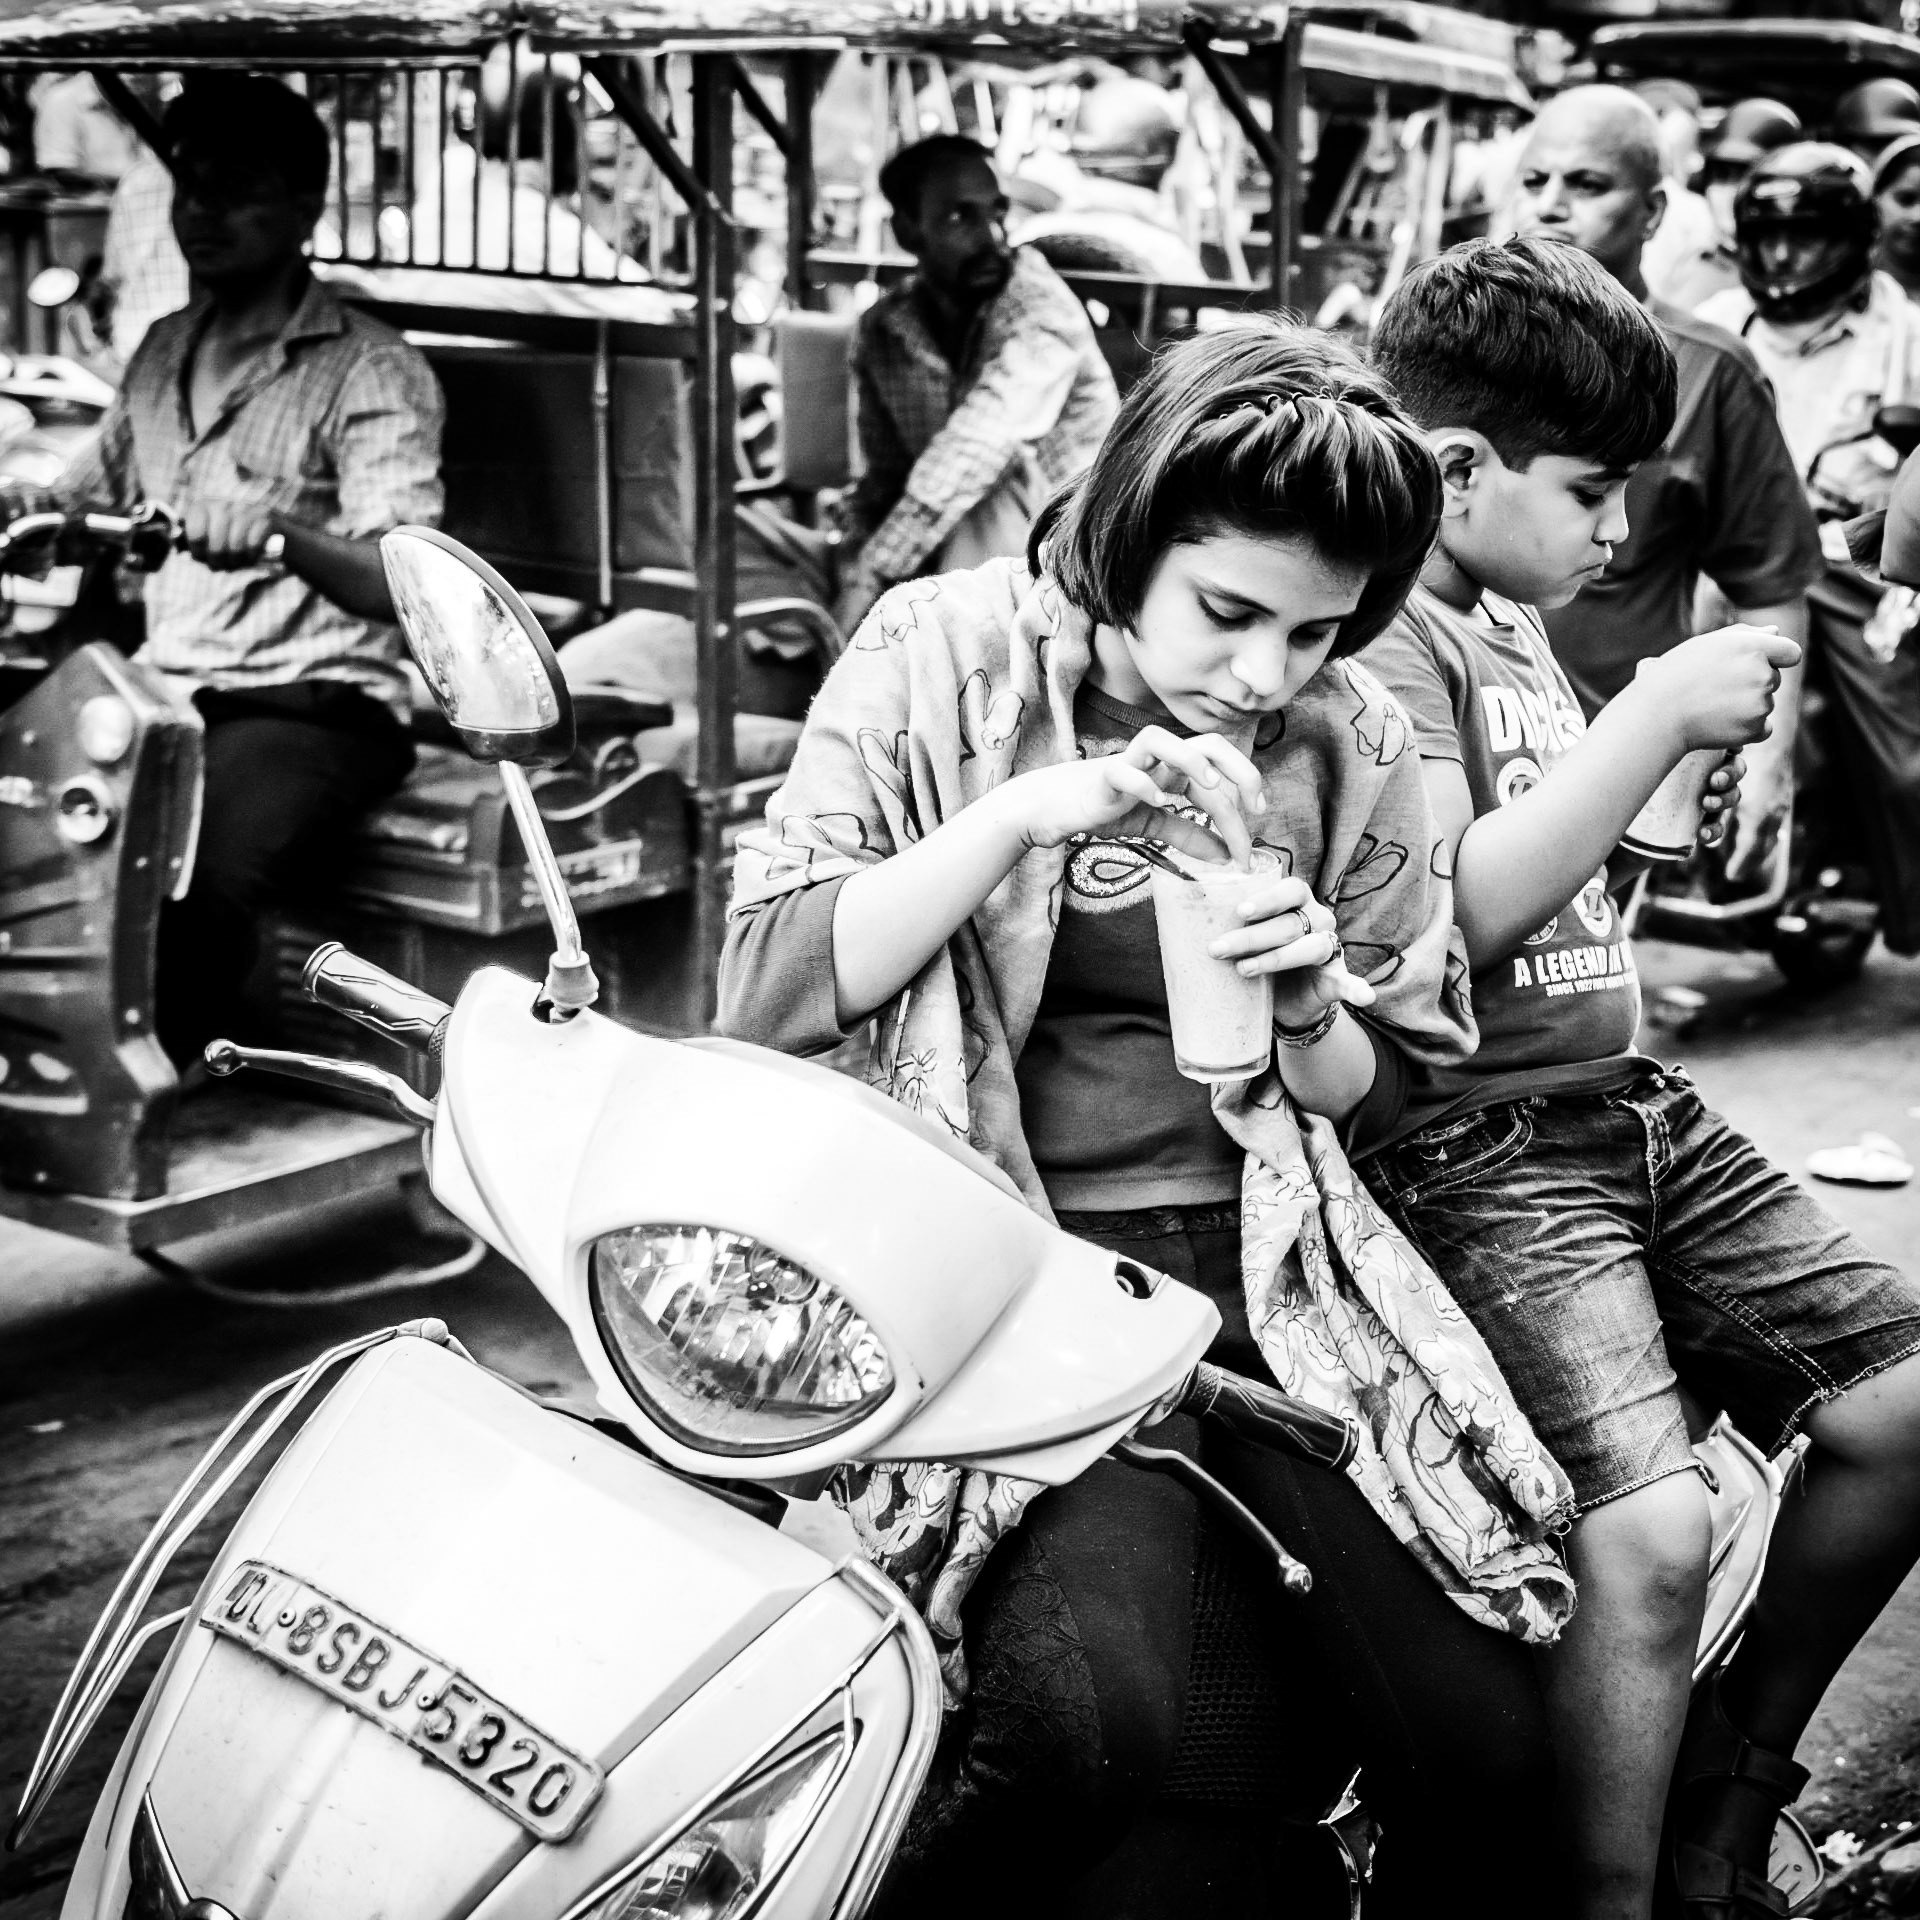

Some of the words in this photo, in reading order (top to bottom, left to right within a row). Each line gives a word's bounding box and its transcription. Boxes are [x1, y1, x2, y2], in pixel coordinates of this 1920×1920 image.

[1514, 957, 1532, 988] A
[1535, 945, 1608, 985] LEGEND
[1545, 981, 1575, 998] SINCE
